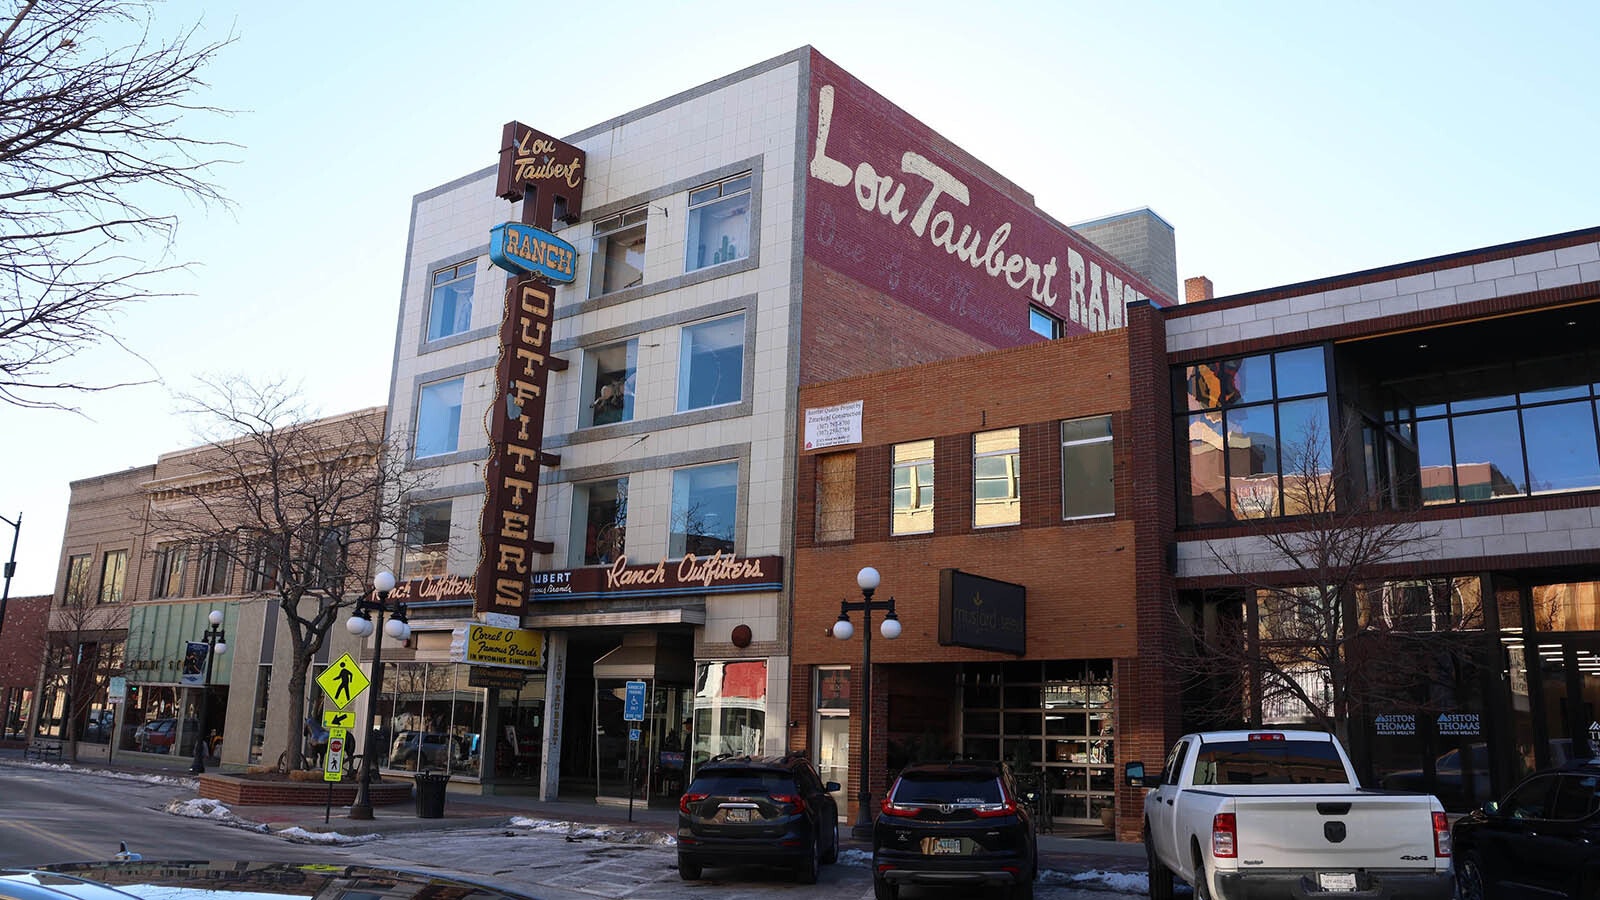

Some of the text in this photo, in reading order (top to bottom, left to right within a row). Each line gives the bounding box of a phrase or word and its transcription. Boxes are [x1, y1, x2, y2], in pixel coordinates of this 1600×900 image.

[518, 129, 557, 157] Lou
[514, 155, 582, 189] Taubert
[810, 84, 909, 224] Lou
[901, 151, 1058, 307] Taubert
[506, 228, 573, 275] RANCH
[496, 286, 550, 608] OUTFITTERS
[606, 549, 764, 589] Ranch Outfitters
[371, 573, 477, 601] Rnch Outfitters
[472, 627, 503, 642] Corral
[470, 653, 477, 661] IN
[478, 654, 507, 664] WYOMING
[509, 657, 526, 666] SINCE
[477, 641, 537, 657] Famous Brands
[1375, 722, 1416, 730] THOMAS
[1438, 722, 1480, 730] THOMAS
